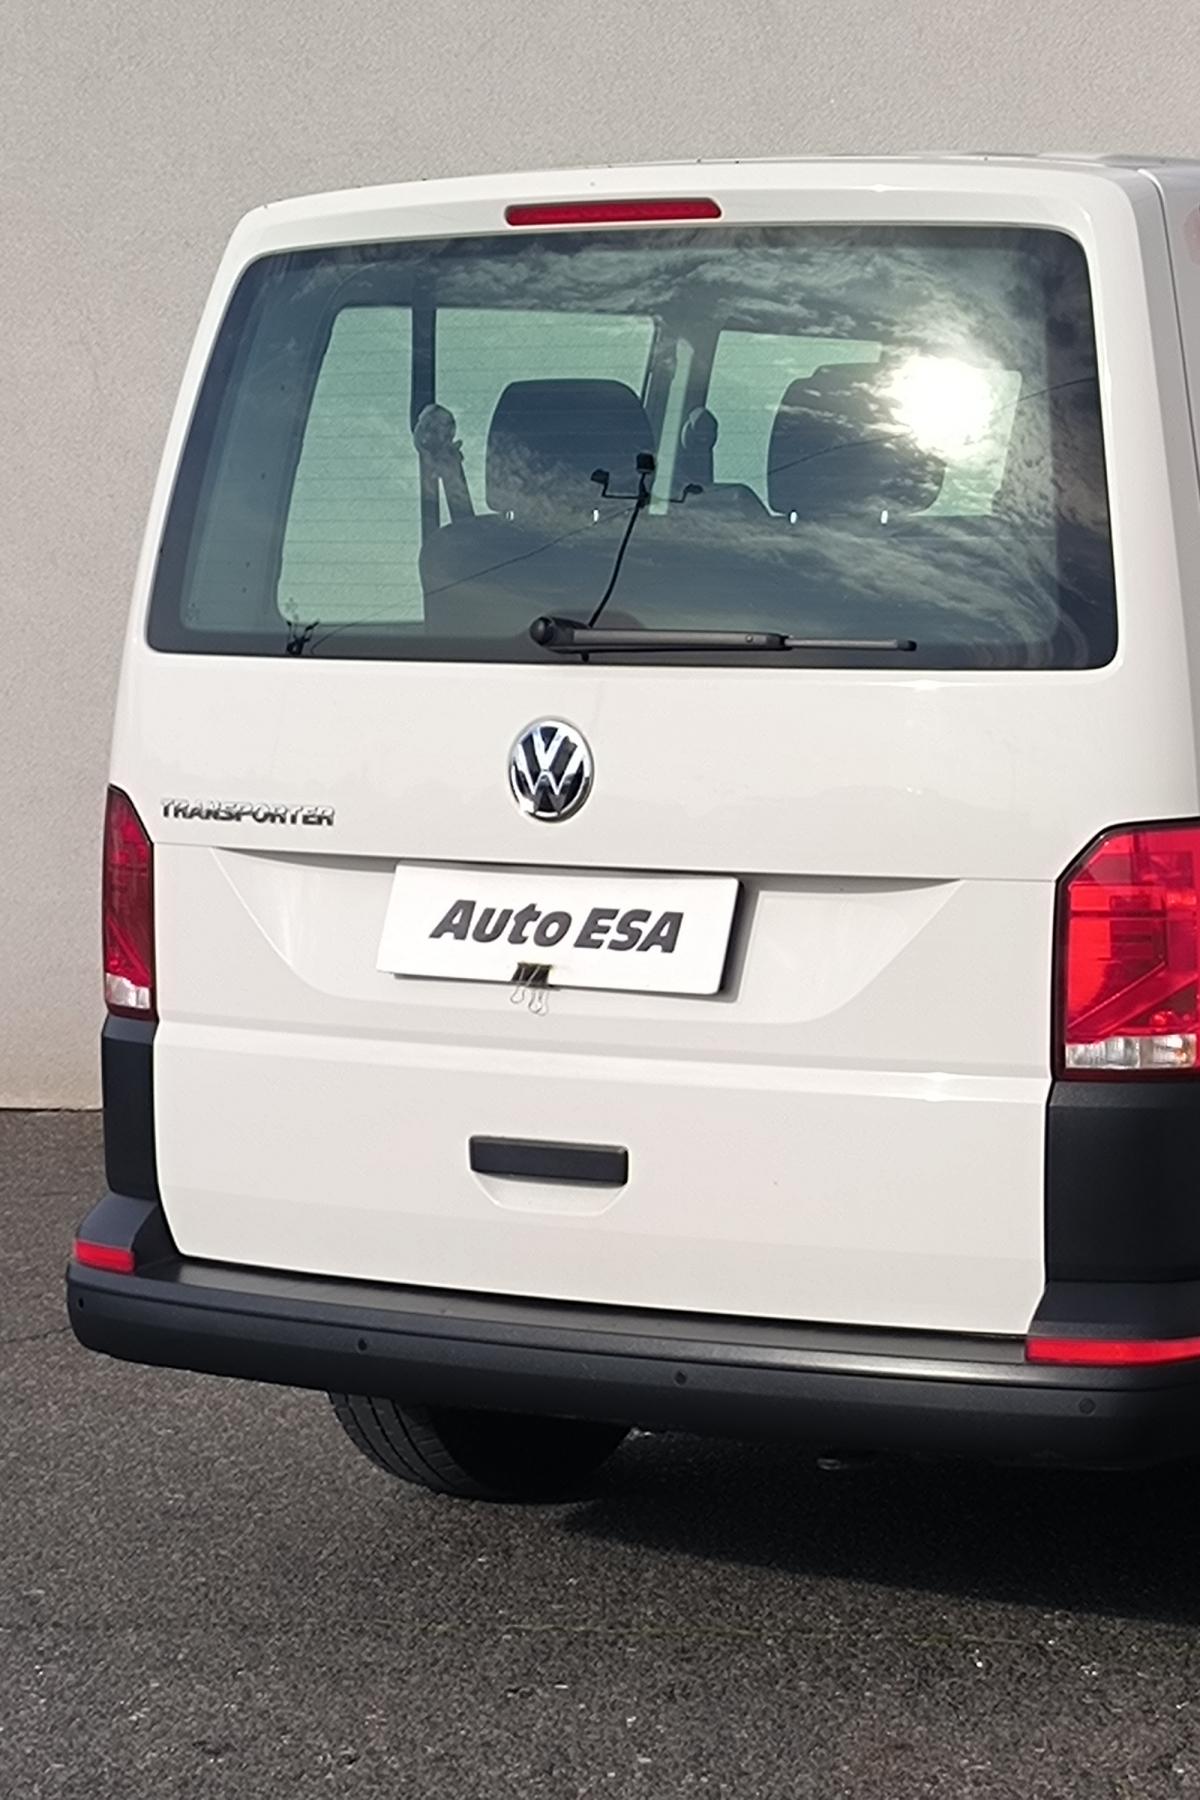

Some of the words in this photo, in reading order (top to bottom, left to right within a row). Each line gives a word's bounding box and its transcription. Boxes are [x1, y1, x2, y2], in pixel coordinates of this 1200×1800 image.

[510, 721, 591, 819] VW
[161, 798, 335, 826] TRANSPORTER
[430, 899, 572, 947] Auto
[574, 907, 684, 953] ESA
